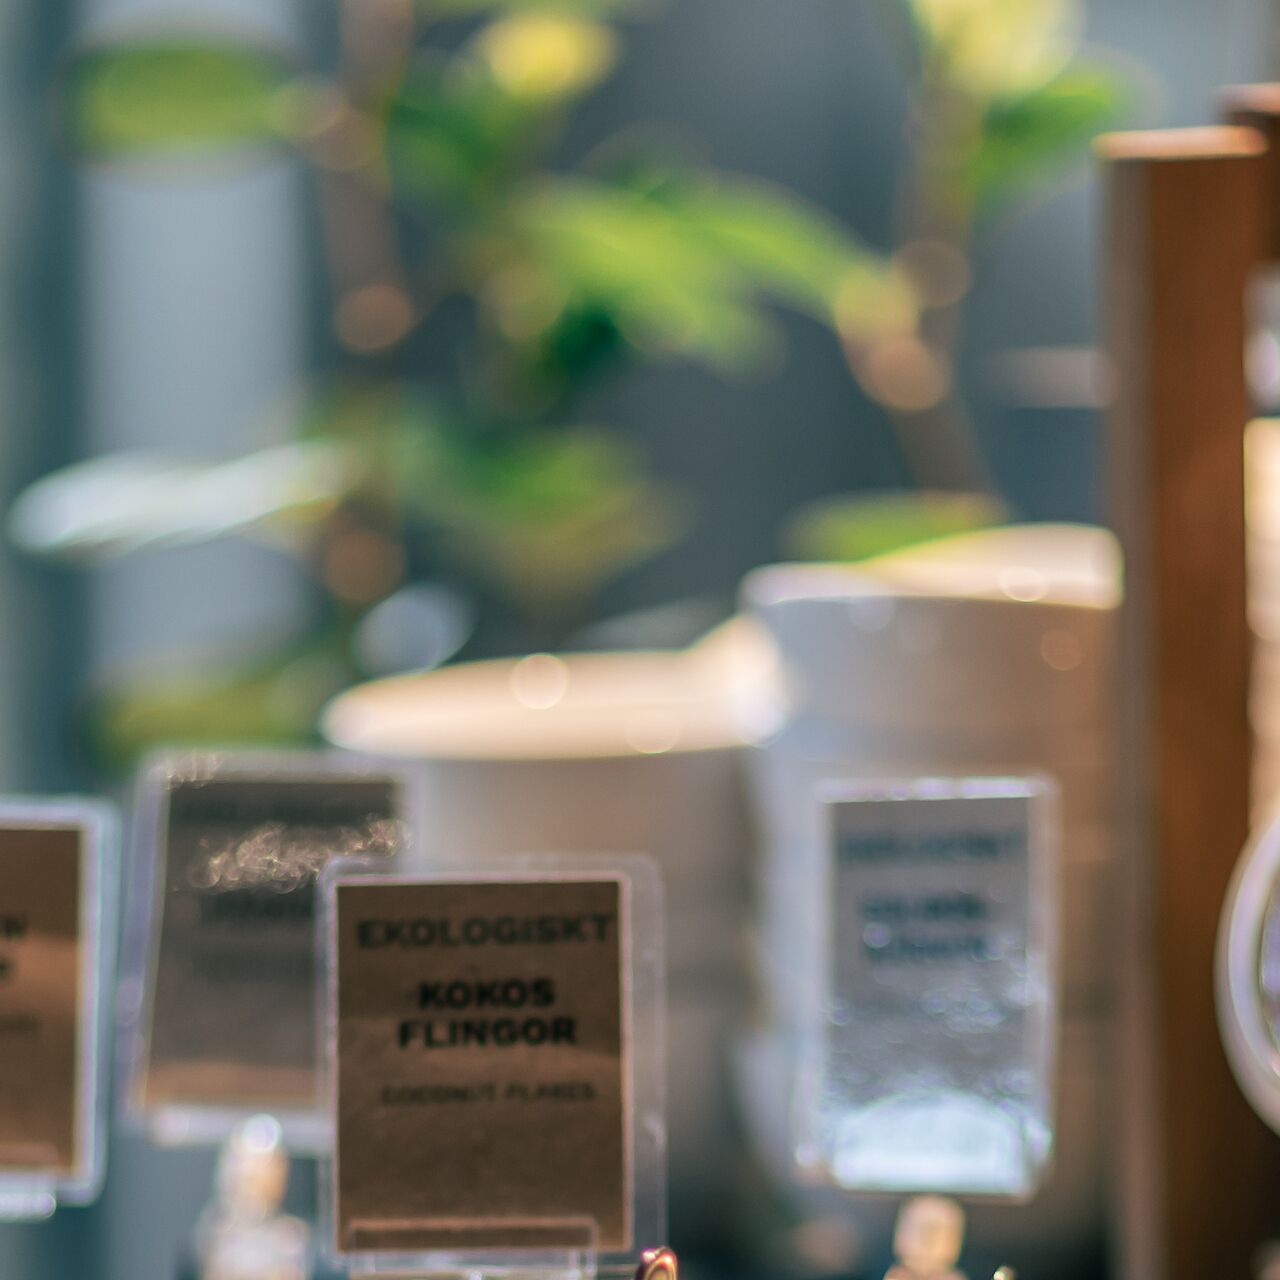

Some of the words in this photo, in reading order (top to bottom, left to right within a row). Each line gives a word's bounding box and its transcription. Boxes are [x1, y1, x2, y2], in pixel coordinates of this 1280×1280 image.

[357, 913, 614, 948] EKOLOGISKT
[419, 976, 557, 1010] KOKOS
[398, 1016, 579, 1049] FLINGOR
